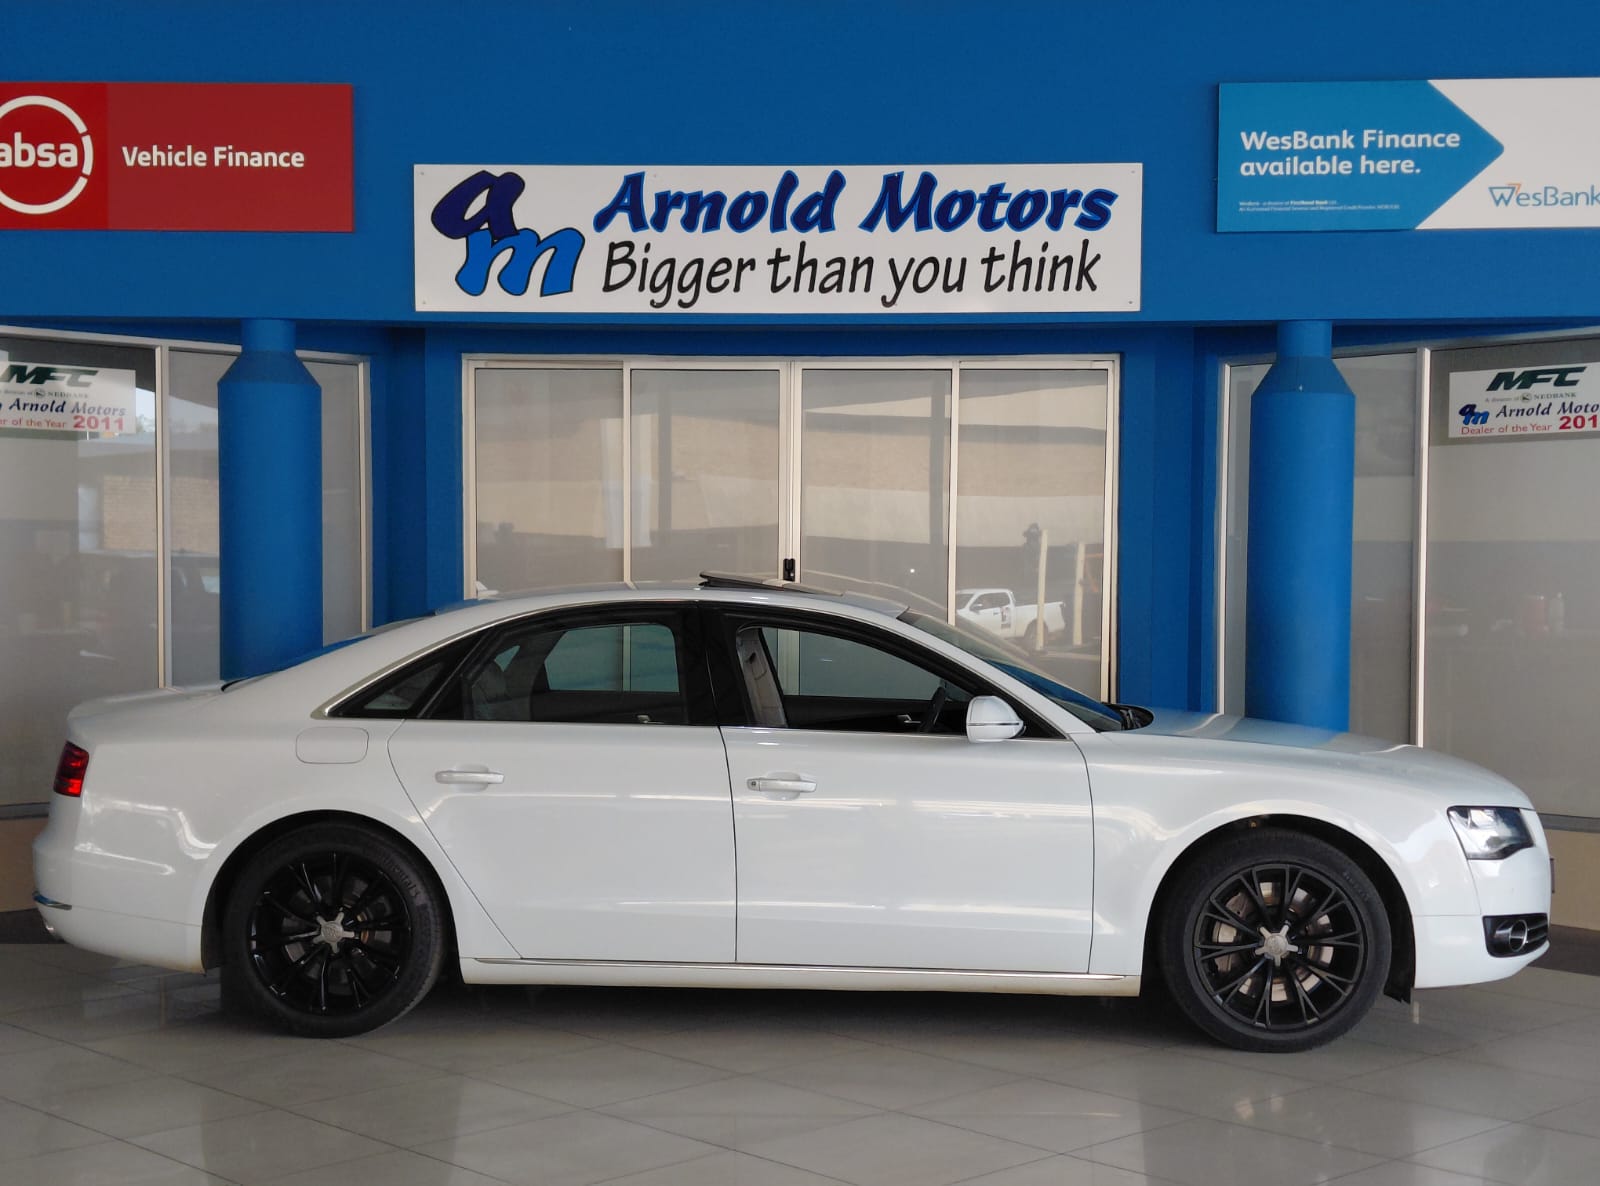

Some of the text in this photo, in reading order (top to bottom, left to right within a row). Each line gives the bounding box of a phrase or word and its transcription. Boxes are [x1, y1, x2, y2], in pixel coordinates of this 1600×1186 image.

[0, 131, 78, 168] absa
[1240, 129, 1461, 151] WesBank Finance
[122, 145, 305, 168] Vehicle Finance
[1240, 154, 1421, 177] available here.
[593, 170, 1119, 233] Arnold Motors
[1488, 184, 1600, 207] WesBank
[602, 238, 1101, 308] Bigger than you think
[1486, 366, 1587, 391] MFC
[9, 398, 66, 413] Arnold
[71, 402, 126, 416] Motors
[1496, 402, 1552, 418] Arnold
[1557, 401, 1600, 415] Moto
[73, 415, 125, 430] 2011
[1461, 415, 1598, 435] Dealer of the Year 201
